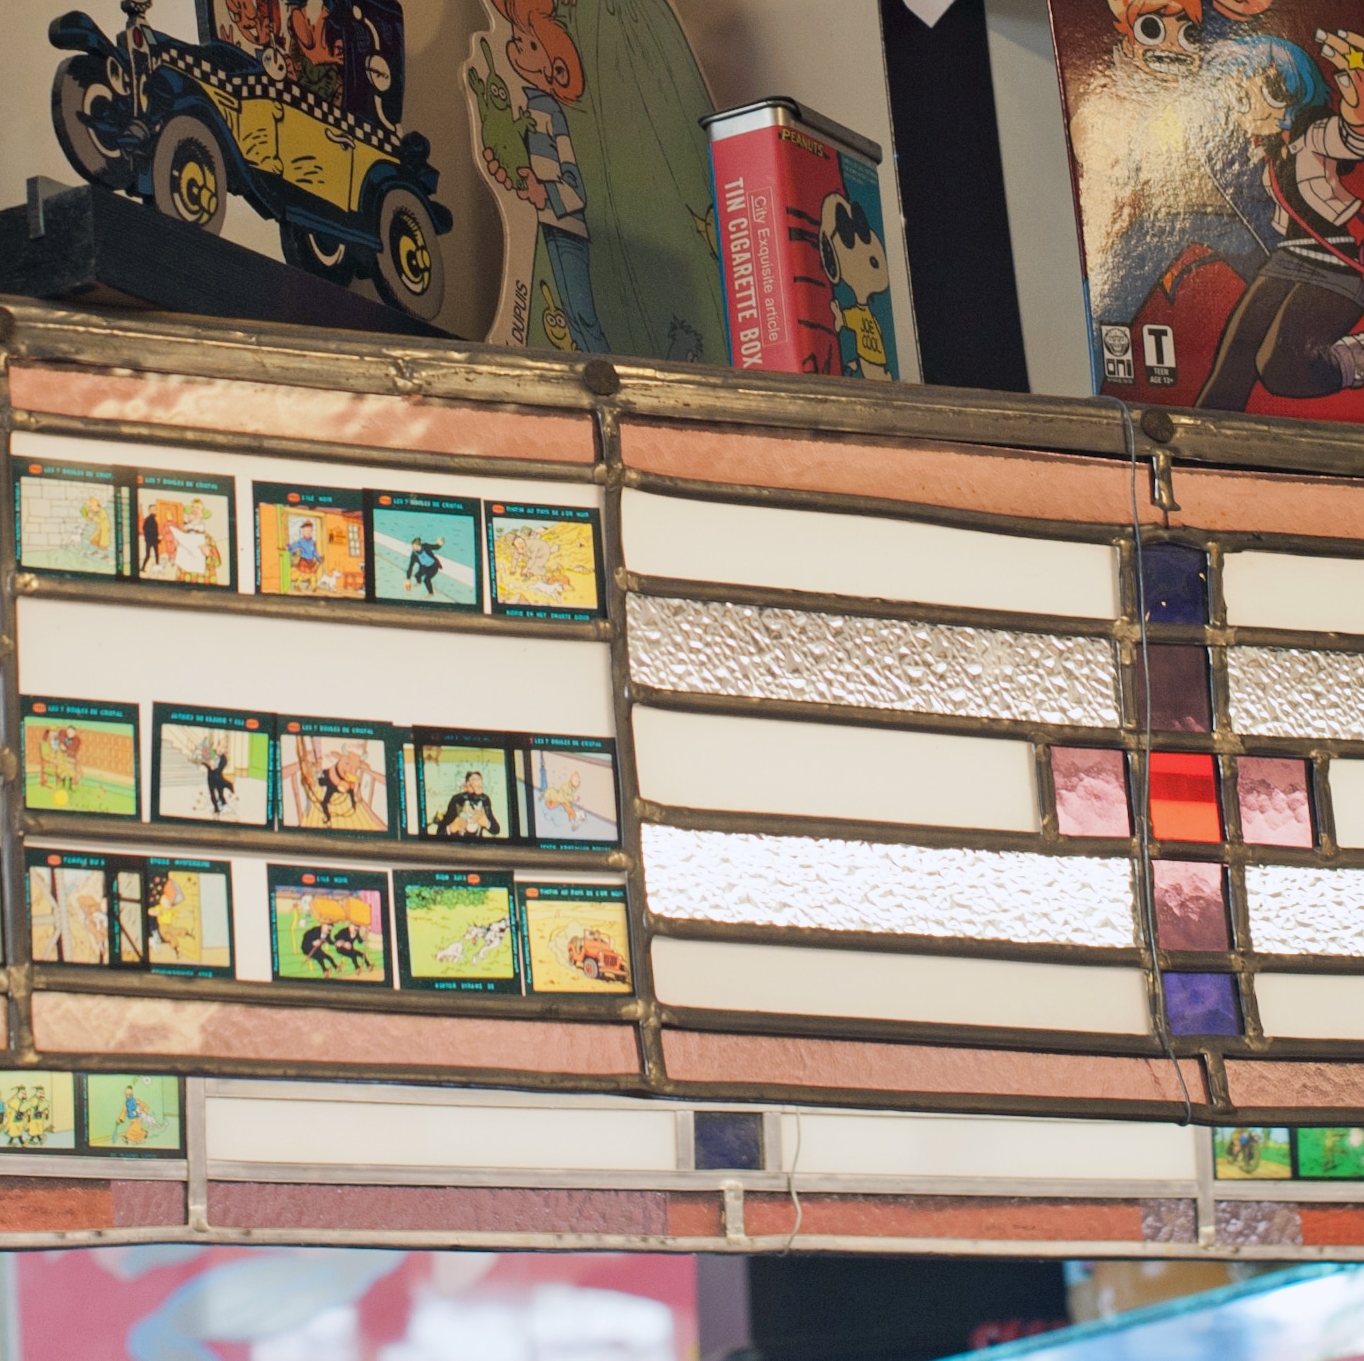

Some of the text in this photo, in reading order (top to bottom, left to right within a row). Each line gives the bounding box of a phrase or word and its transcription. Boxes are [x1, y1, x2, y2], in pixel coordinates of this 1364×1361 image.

[779, 128, 829, 160] PEANUTS
[724, 176, 764, 369] TIN CIGARETTE BOX
[750, 195, 779, 342] City Exquisite article
[511, 279, 528, 345] DUPUIS
[860, 316, 875, 334] JOE
[862, 335, 882, 354] COOL
[1147, 328, 1168, 365] T
